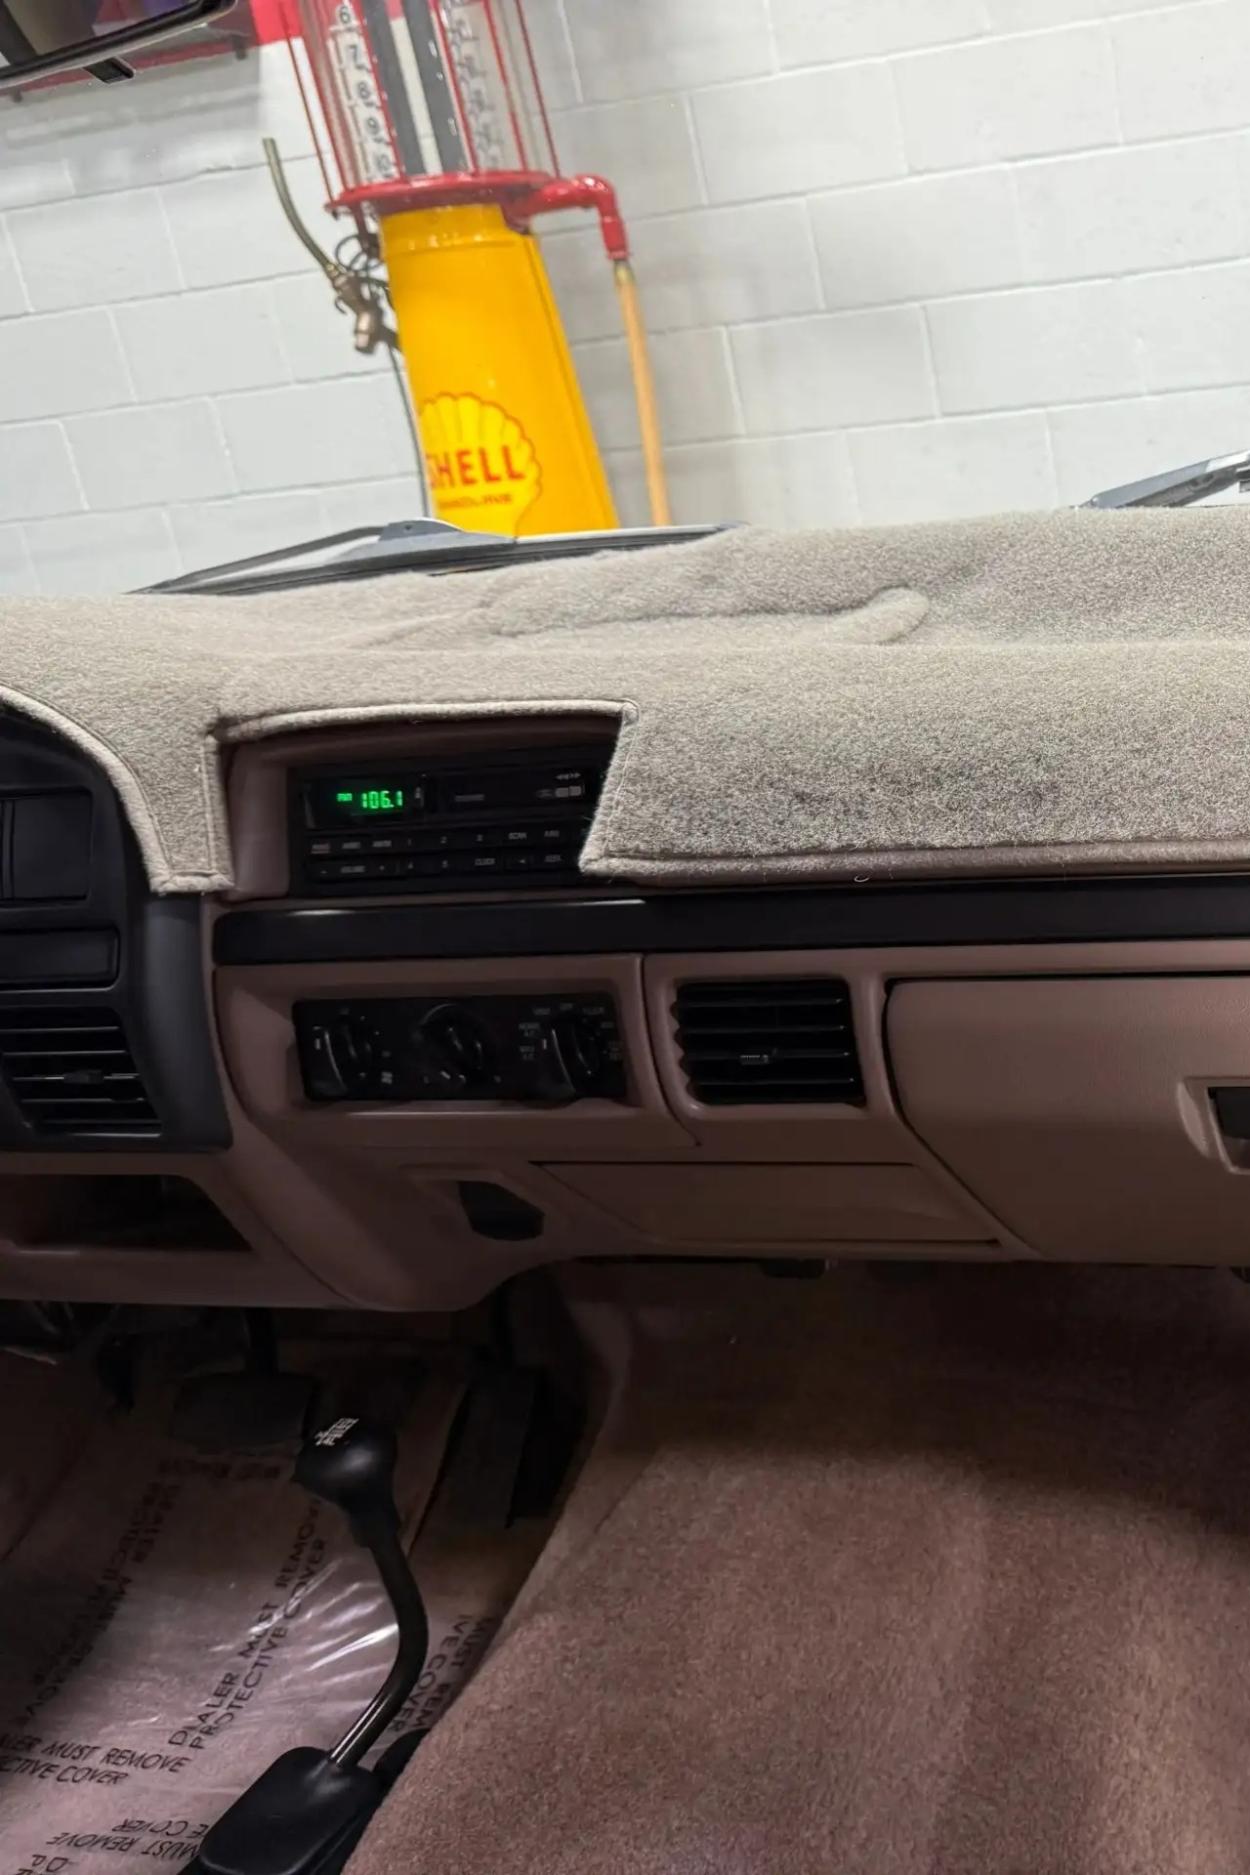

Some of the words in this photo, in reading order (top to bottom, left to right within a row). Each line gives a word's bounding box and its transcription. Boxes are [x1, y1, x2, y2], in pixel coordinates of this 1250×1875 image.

[41, 1740, 101, 1761] MUST
[100, 1748, 192, 1773] REMOVE
[56, 1765, 129, 1785] COVER
[46, 1832, 139, 1852] REMOVE
